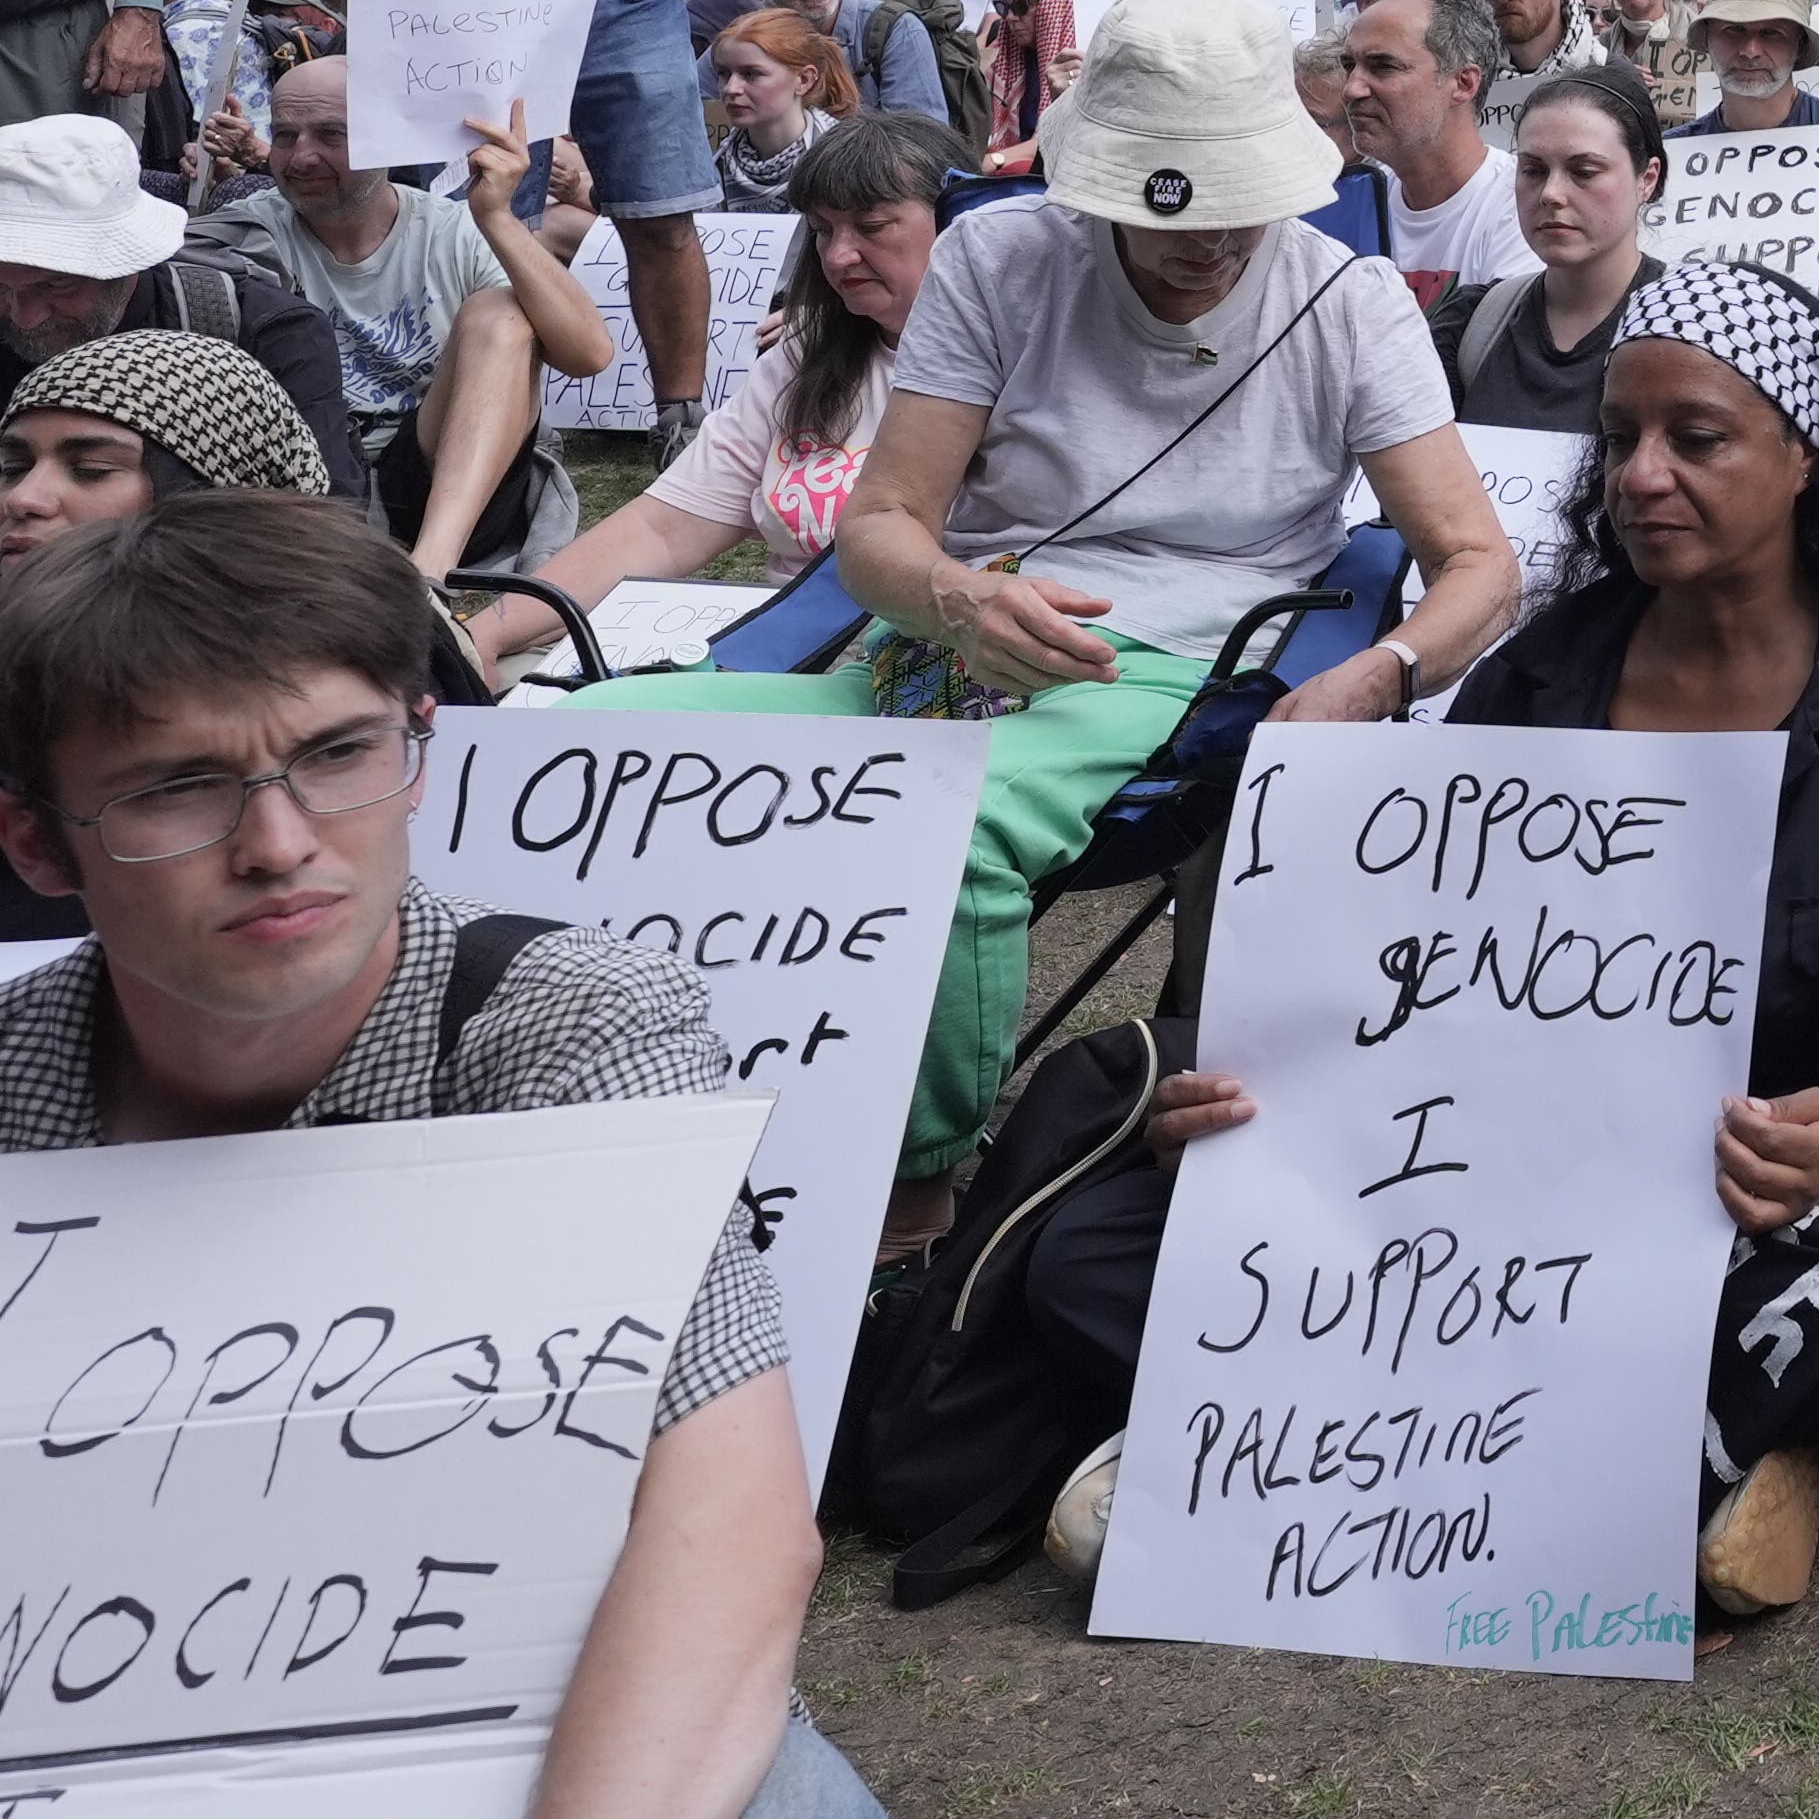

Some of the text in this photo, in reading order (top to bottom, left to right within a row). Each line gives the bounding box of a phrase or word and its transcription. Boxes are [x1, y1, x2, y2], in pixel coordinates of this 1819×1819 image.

[1150, 177, 1188, 188] CEASE
[1153, 193, 1182, 205] NOW
[1154, 185, 1182, 194] FIRE
[583, 223, 618, 266] I
[598, 600, 661, 630] I
[446, 744, 906, 882] I OPPOSE
[1233, 762, 1687, 900] I OPPOSE
[1357, 1095, 1469, 1198] I
[1197, 1225, 1594, 1373] SUPPORT
[38, 1306, 667, 1507] OPPOSE
[1265, 1493, 1497, 1601] ACTION.
